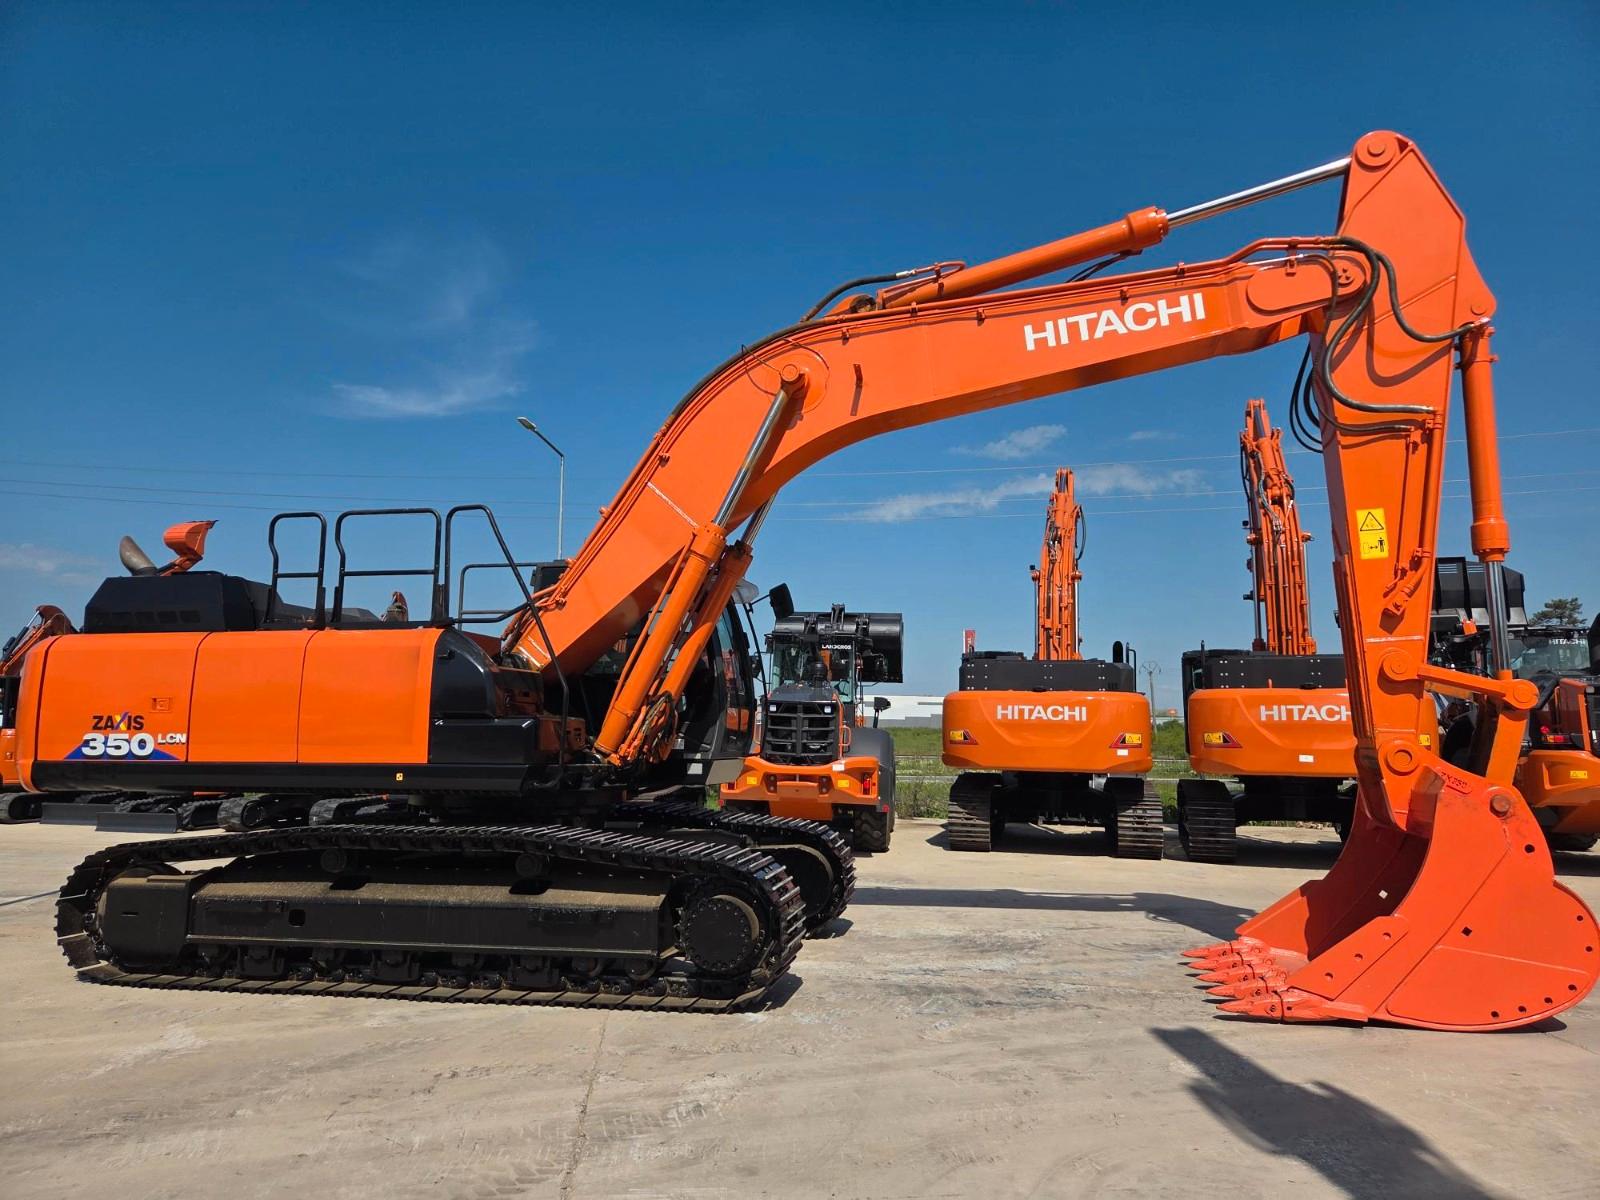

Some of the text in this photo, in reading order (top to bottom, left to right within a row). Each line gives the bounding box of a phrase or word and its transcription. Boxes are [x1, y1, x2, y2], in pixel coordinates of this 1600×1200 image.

[1023, 292, 1206, 351] HITACHI
[92, 711, 144, 731] ZAXIS
[996, 704, 1087, 722] HITACHI
[1260, 704, 1352, 721] HITACH
[81, 732, 187, 757] 350 LCN
